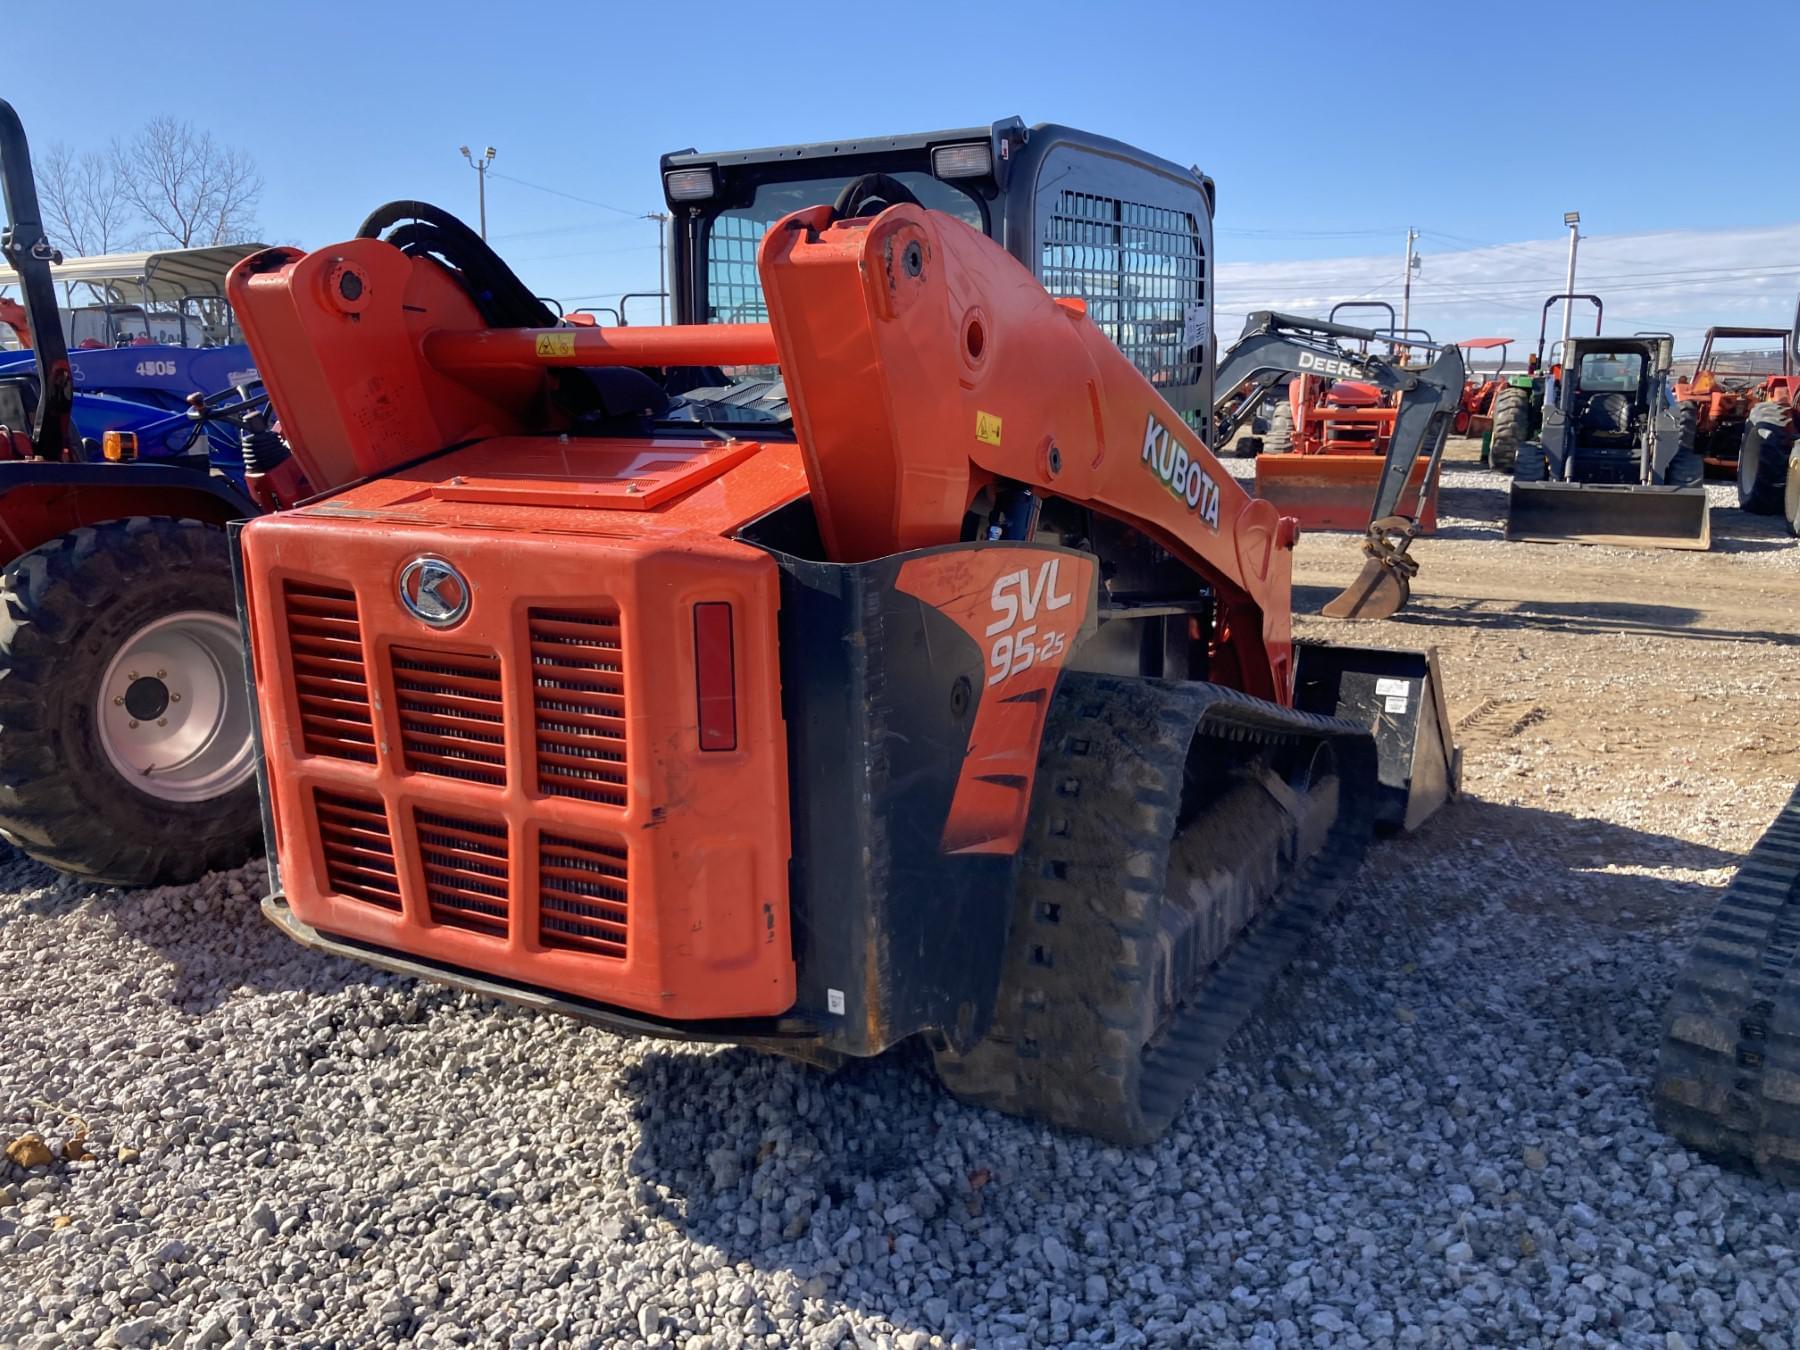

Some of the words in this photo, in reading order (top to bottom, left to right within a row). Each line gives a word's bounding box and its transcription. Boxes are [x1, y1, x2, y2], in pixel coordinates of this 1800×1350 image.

[1298, 351, 1363, 379] DEERE
[1142, 414, 1219, 529] KUBOTA
[986, 559, 1072, 637] SVL
